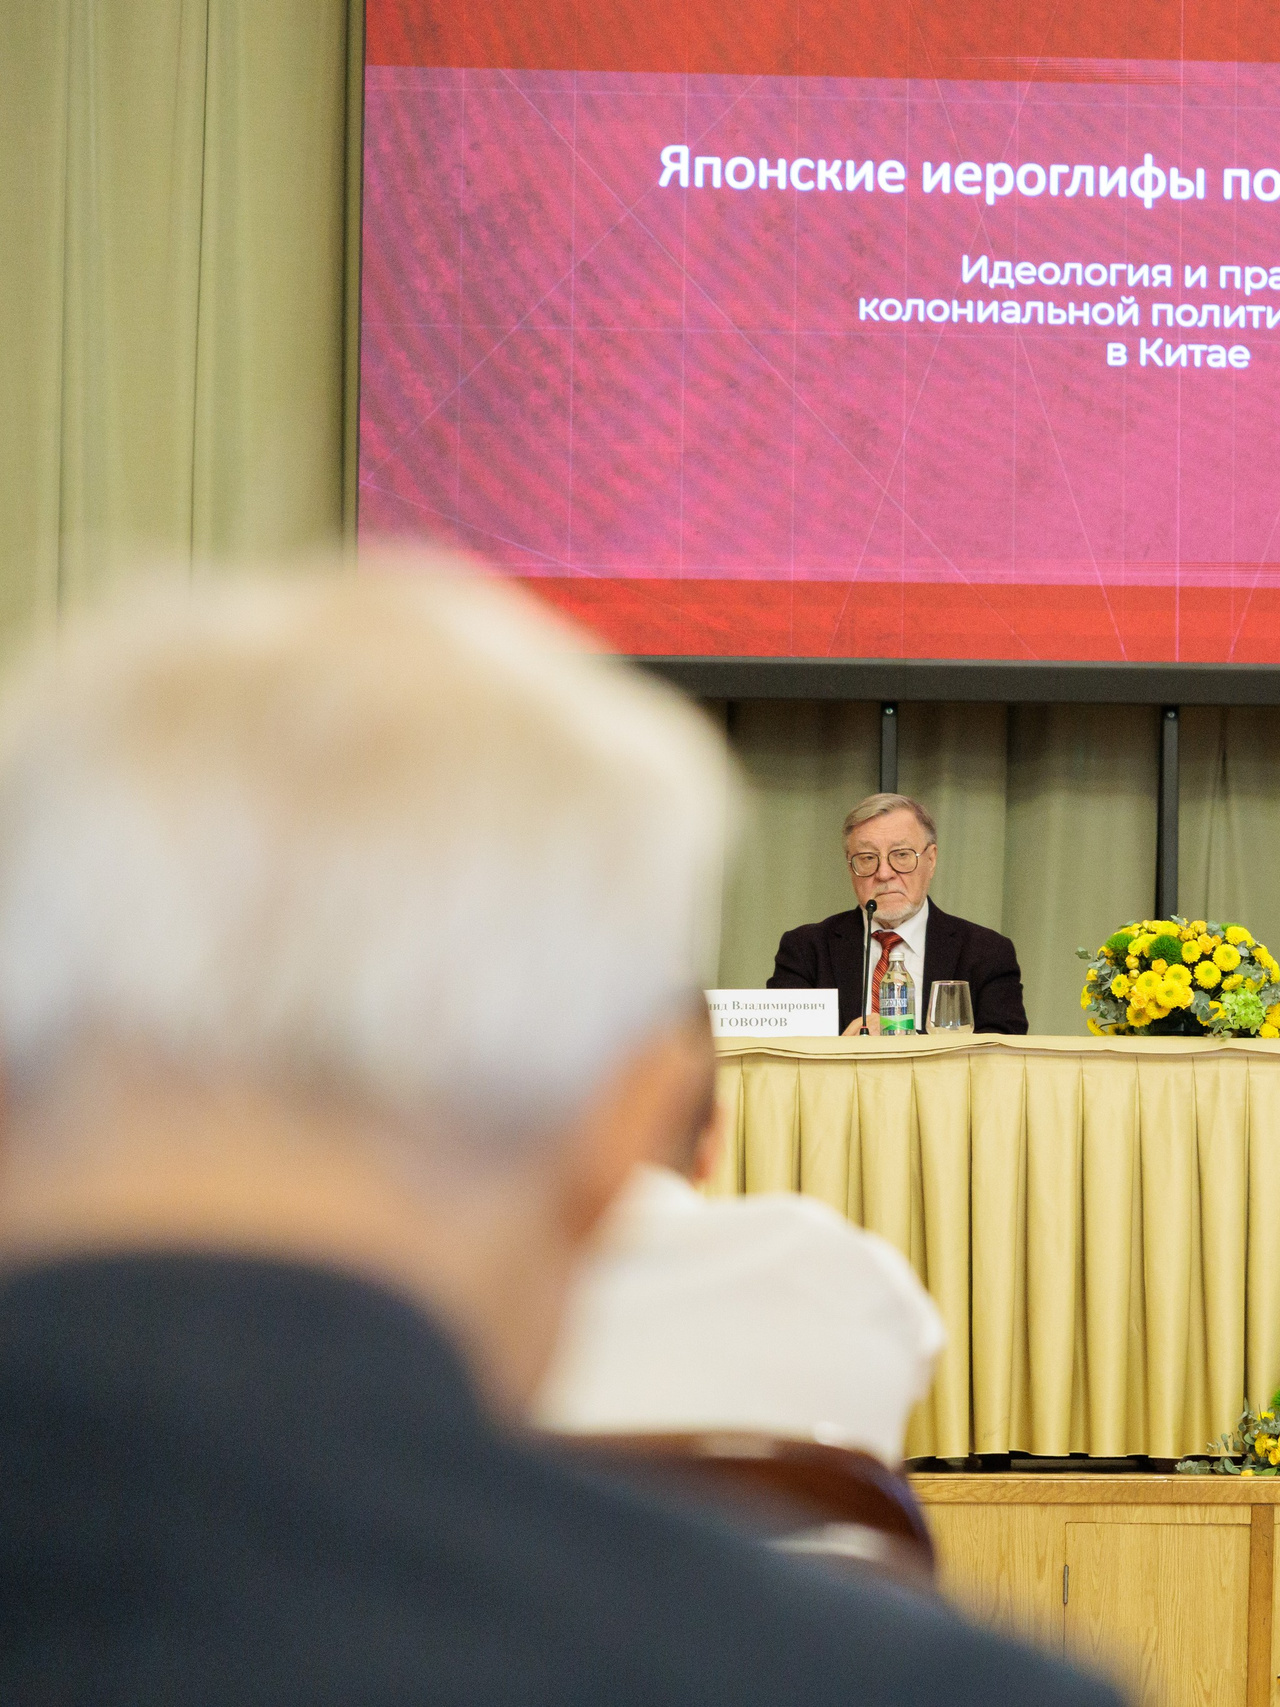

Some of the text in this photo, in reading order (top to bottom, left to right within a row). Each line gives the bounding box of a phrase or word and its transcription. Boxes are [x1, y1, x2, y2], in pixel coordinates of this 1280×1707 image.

[657, 143, 907, 195] Японские
[921, 152, 1207, 210] иероглифы
[960, 253, 1173, 289] Идеология
[1183, 263, 1208, 290] и
[858, 294, 1141, 328] колониальной
[1105, 336, 1252, 370] в Китае
[719, 1017, 788, 1028] ГОВОРОВ
[732, 1000, 826, 1013] Владимирович
